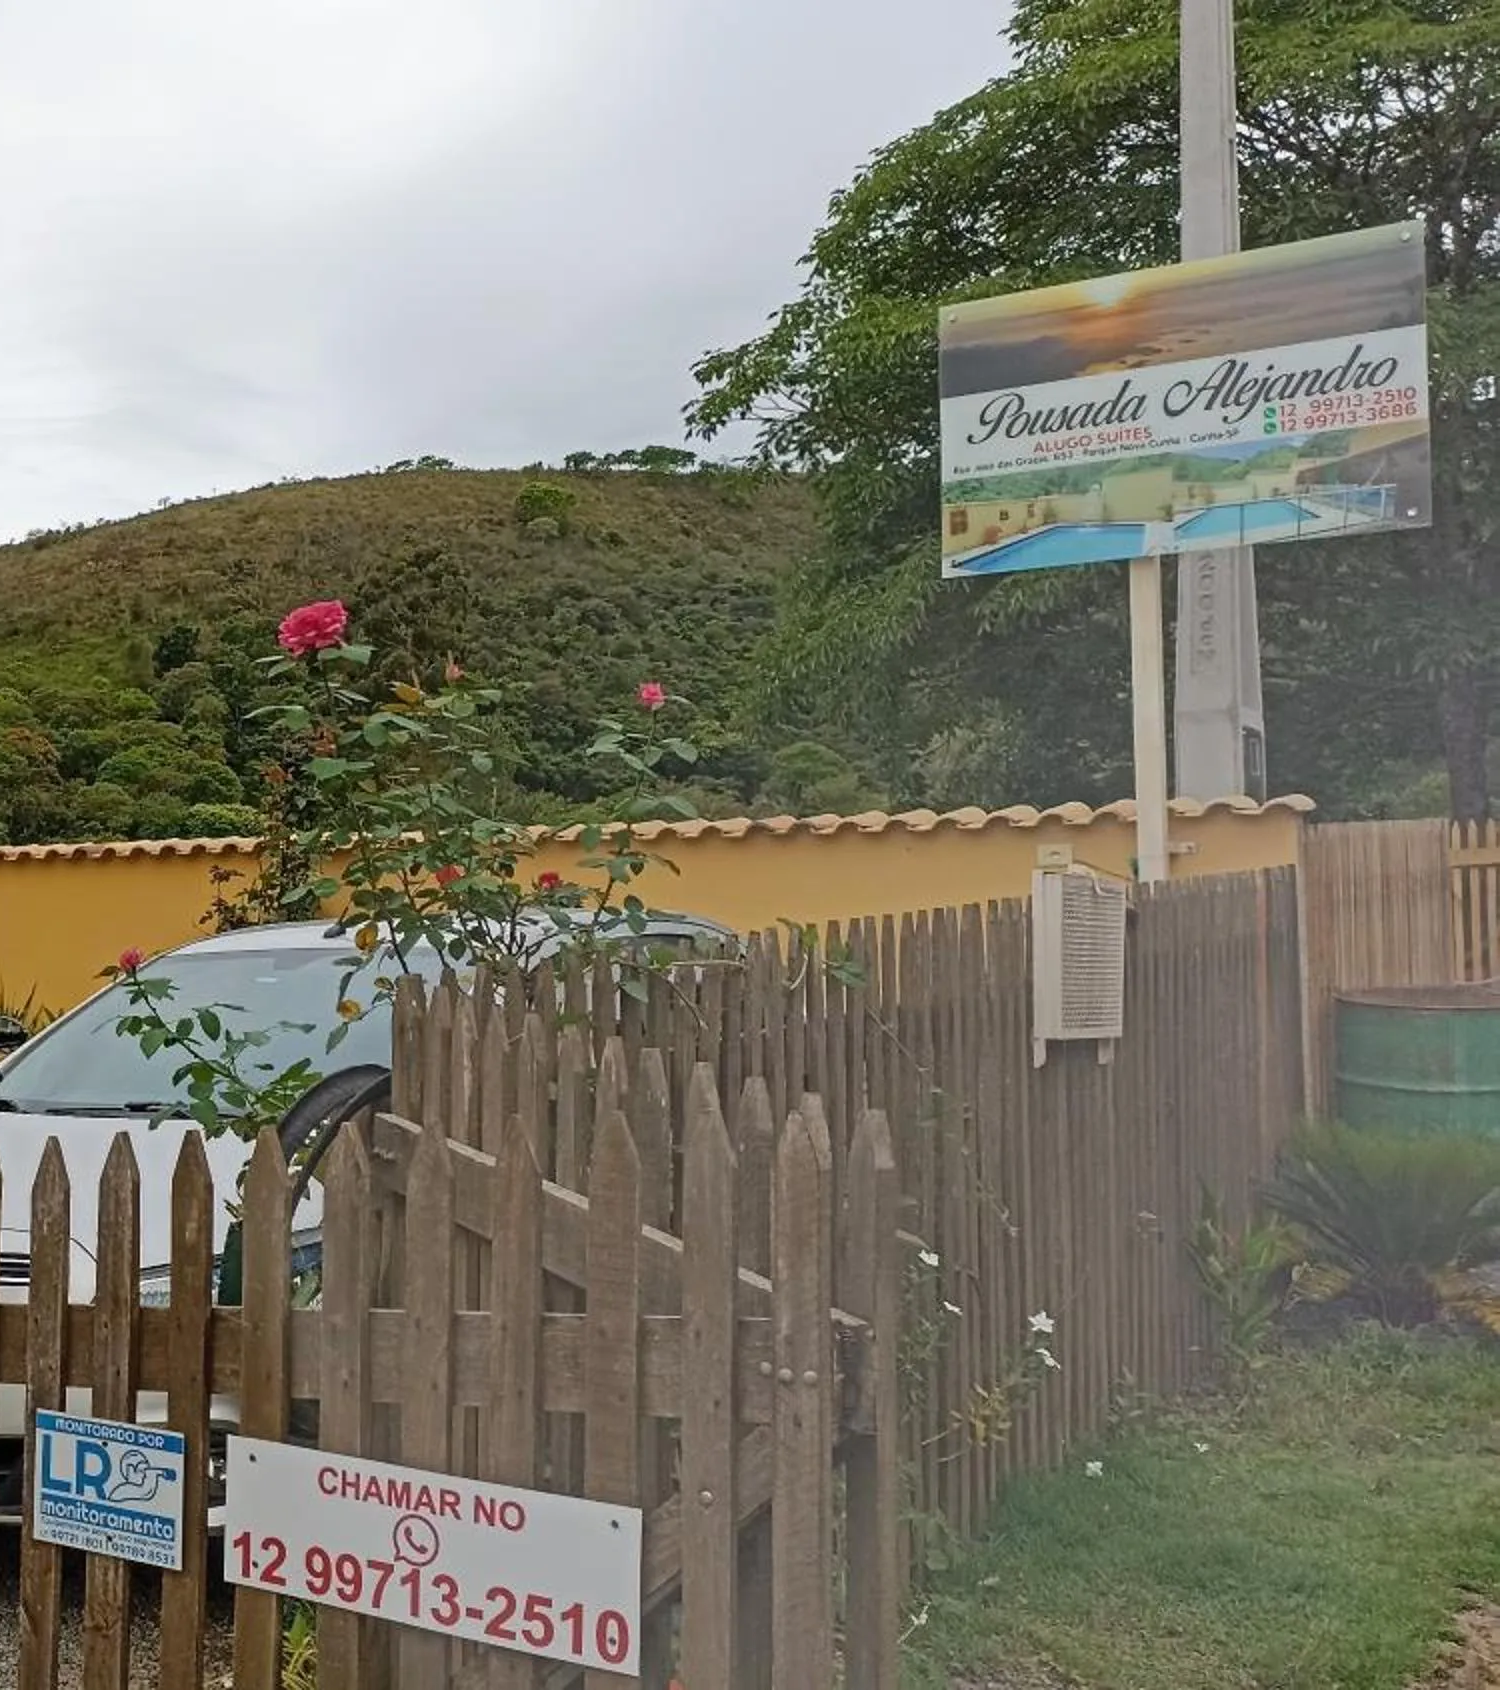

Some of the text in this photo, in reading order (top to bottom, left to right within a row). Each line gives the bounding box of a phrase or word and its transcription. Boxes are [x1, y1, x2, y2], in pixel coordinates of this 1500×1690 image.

[967, 344, 1398, 444] Pousada Alejandro
[1280, 386, 1417, 416] 12 99713-2510
[1280, 401, 1417, 432] 12 99713-3686
[1033, 435, 1092, 453] ALUGO
[55, 1418, 165, 1449] MONITORADO POR
[41, 1433, 112, 1501] LR
[42, 1499, 173, 1539] monitoramento
[317, 1466, 525, 1532] CHAMAR NO
[233, 1531, 287, 1587] 12
[305, 1545, 630, 1665] 99713-2510
